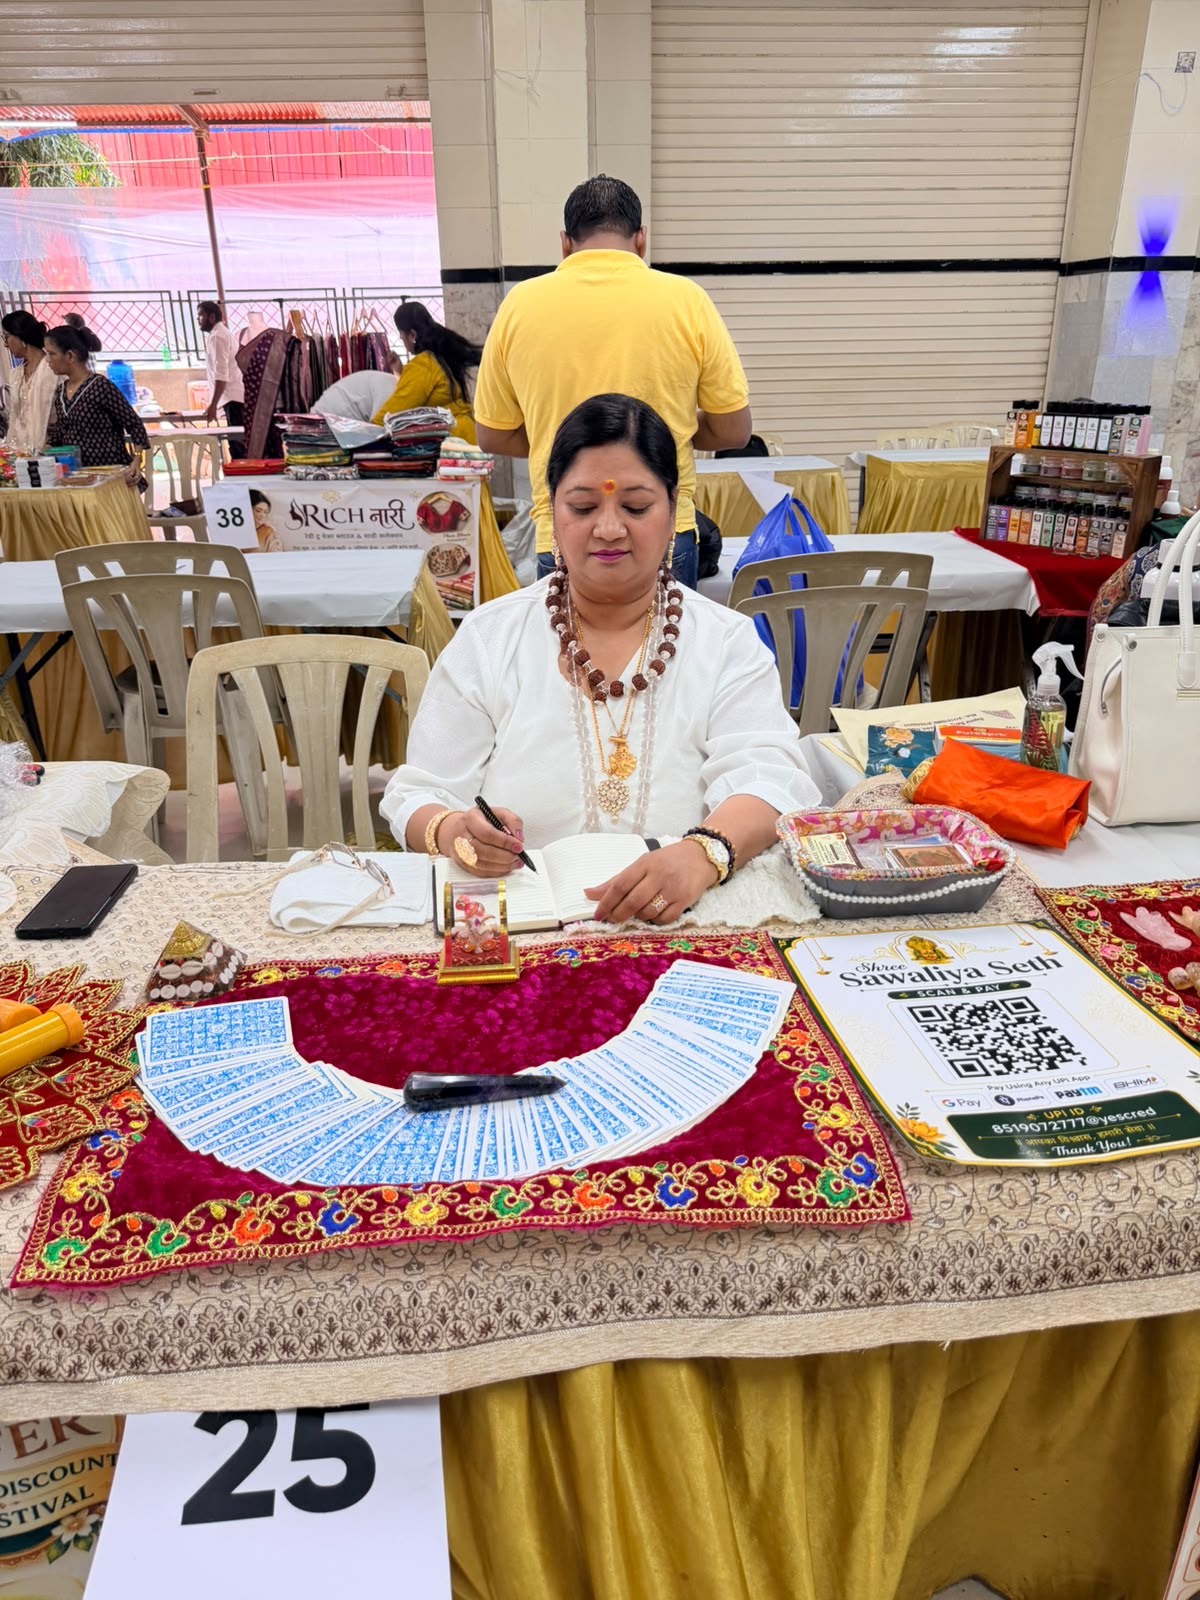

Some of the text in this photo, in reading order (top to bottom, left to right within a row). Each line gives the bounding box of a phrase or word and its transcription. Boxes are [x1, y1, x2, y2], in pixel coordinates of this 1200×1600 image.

[216, 507, 245, 529] 38
[303, 499, 415, 530] RICH नारी
[840, 953, 1062, 989] Sawaliya Seth
[855, 961, 908, 975] Shree
[917, 983, 1001, 998] SCAN & PAY
[1006, 1081, 1034, 1089] Using
[957, 1097, 981, 1108] Pay
[991, 1106, 1157, 1134] 8519072777@yescred
[1043, 1107, 1085, 1120] UPI ID
[1052, 1136, 1132, 1157] Thank You!
[181, 1404, 376, 1526] 25
